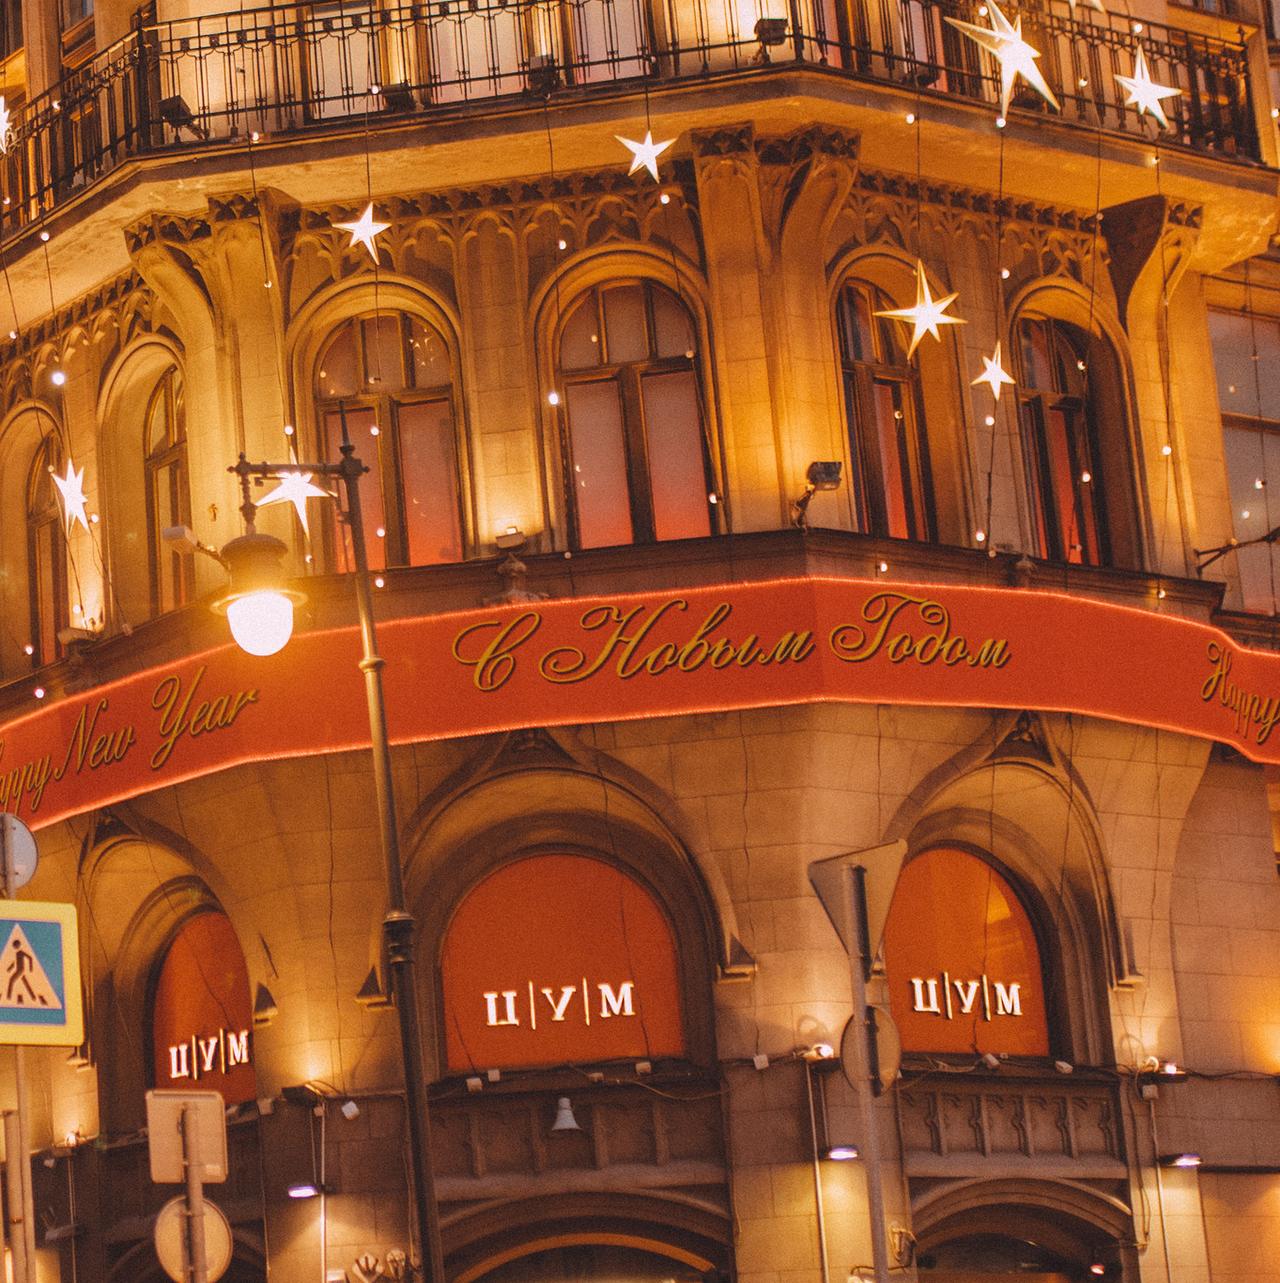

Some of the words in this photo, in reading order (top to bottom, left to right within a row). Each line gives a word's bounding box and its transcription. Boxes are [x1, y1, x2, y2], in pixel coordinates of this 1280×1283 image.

[451, 611, 543, 693] С
[538, 598, 817, 685] Новым
[828, 590, 1013, 669] Годом
[52, 697, 135, 781] New
[150, 665, 260, 770] Year
